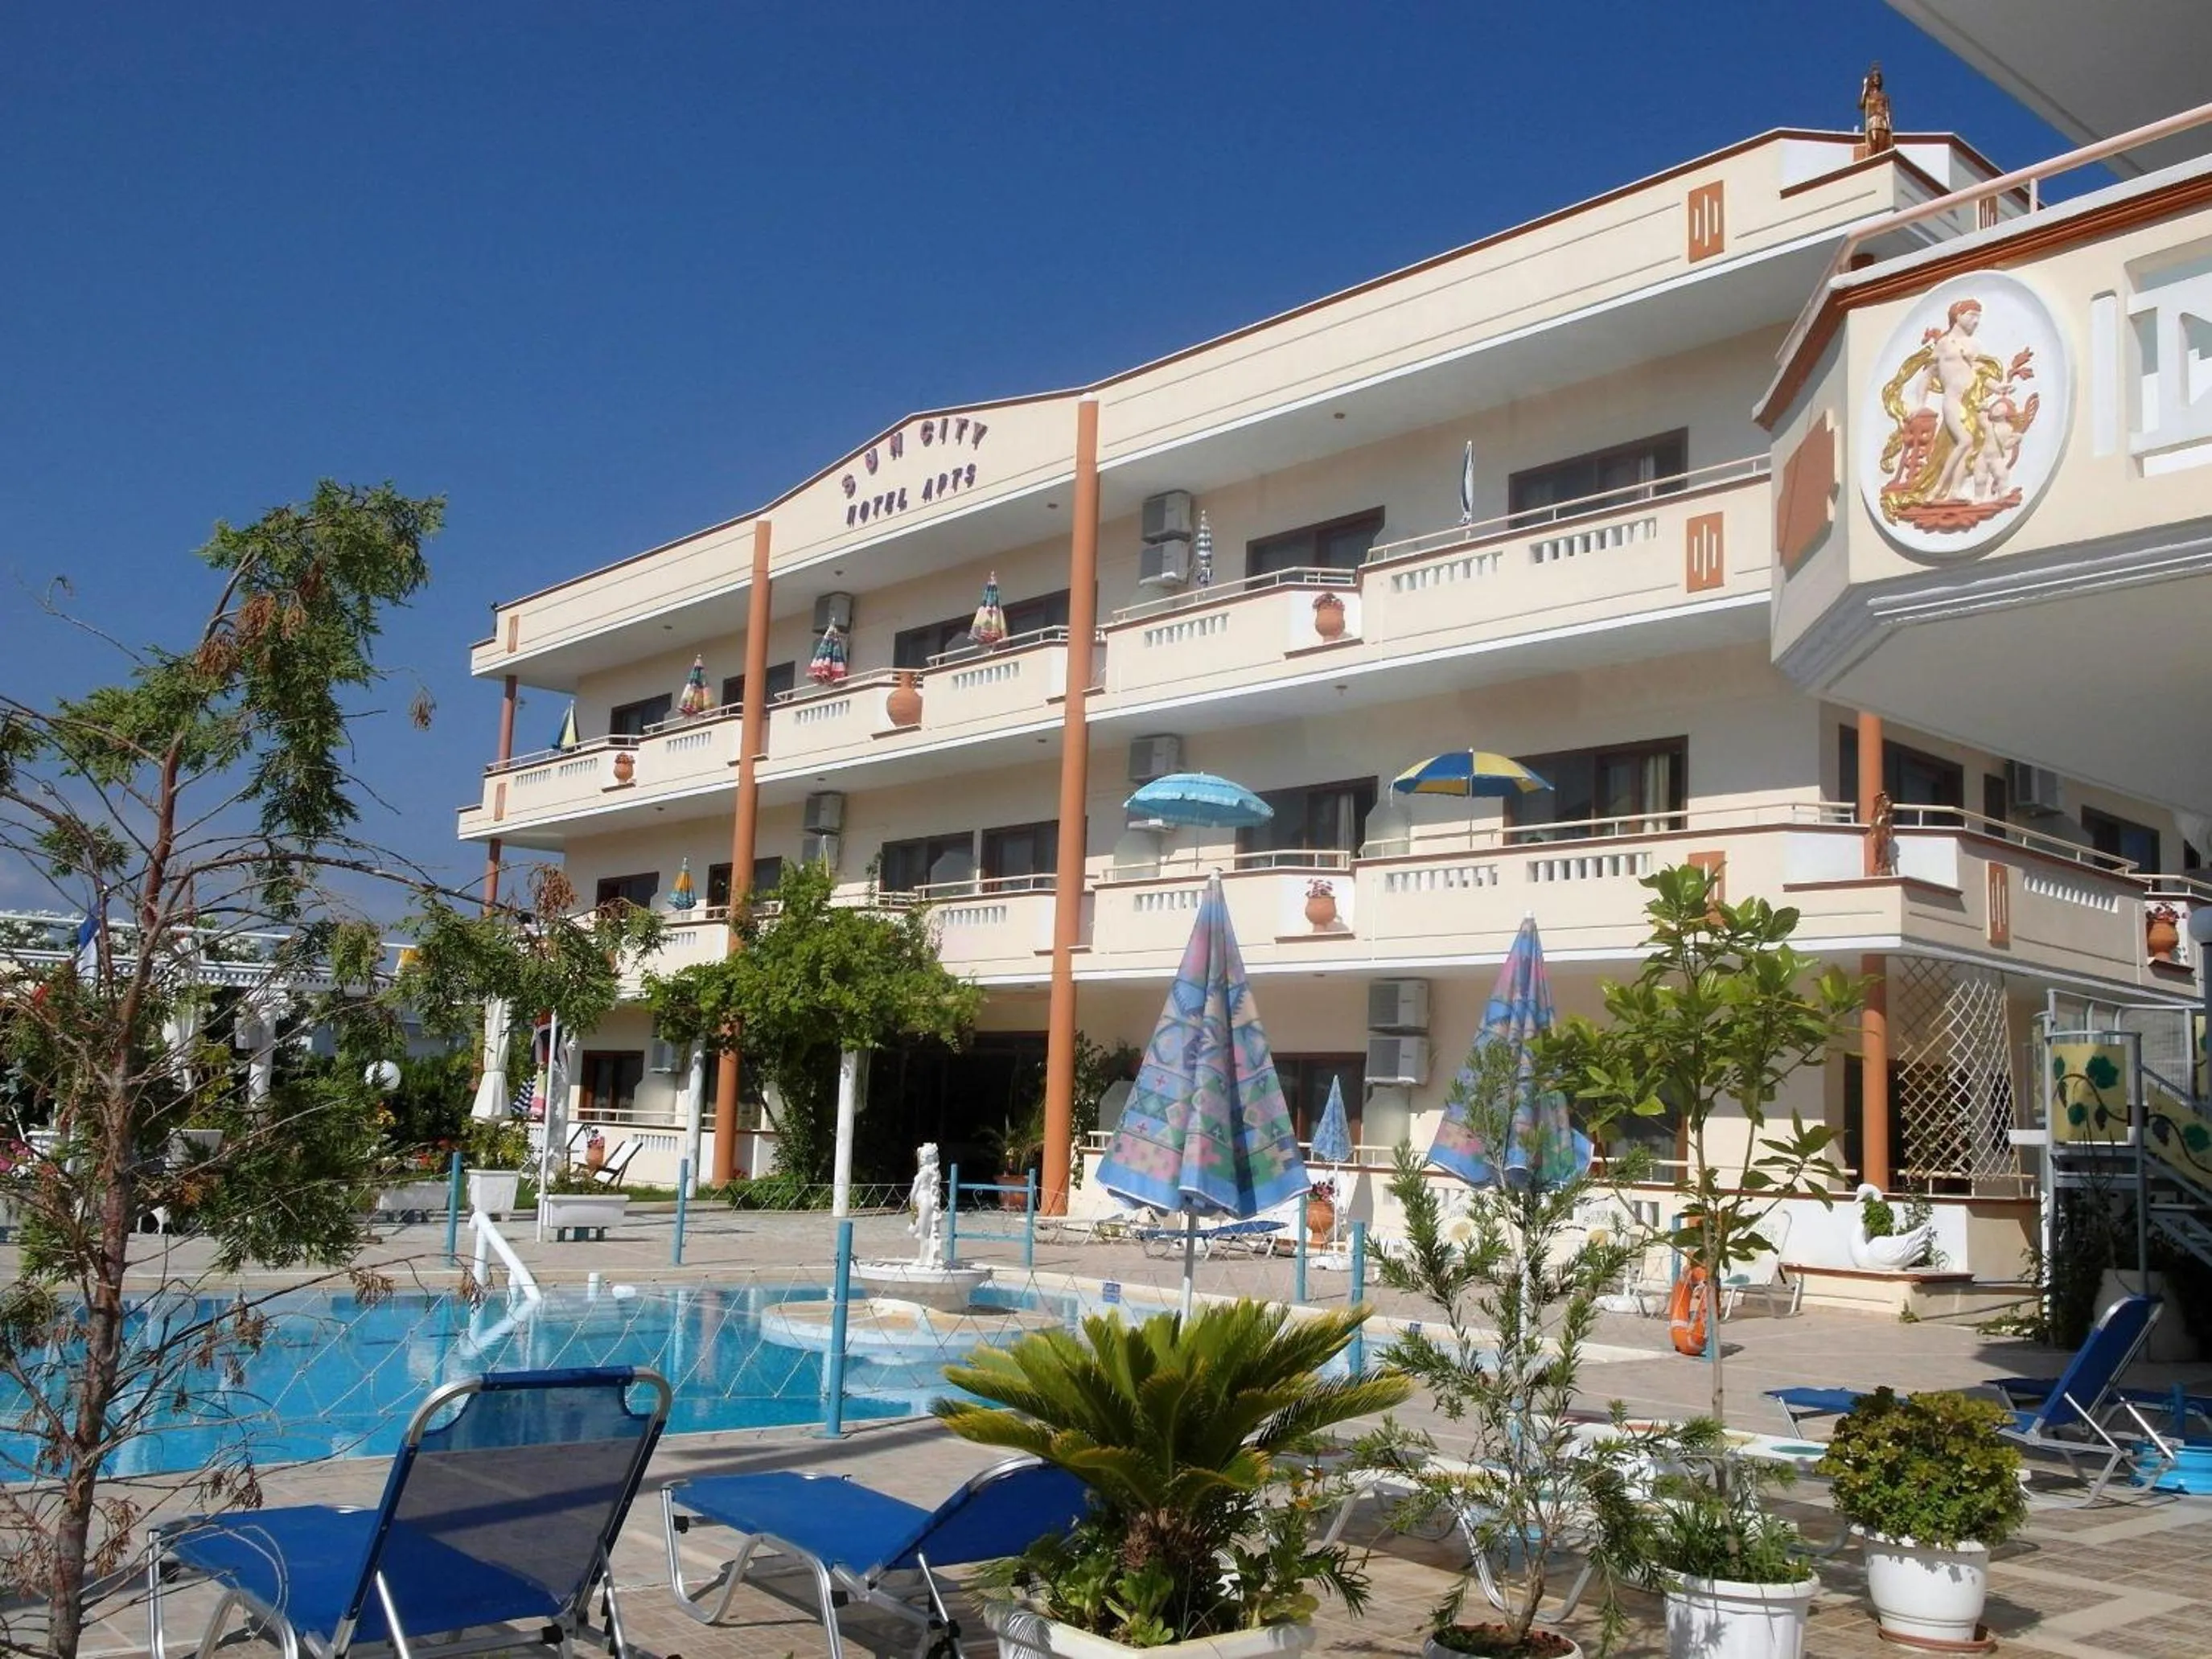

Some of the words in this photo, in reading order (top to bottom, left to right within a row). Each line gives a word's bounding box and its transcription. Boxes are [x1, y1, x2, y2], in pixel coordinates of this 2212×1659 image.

[841, 431, 904, 499] SUN
[919, 417, 989, 450] CITY
[846, 487, 908, 528] HOTEL
[921, 463, 977, 503] APTS
